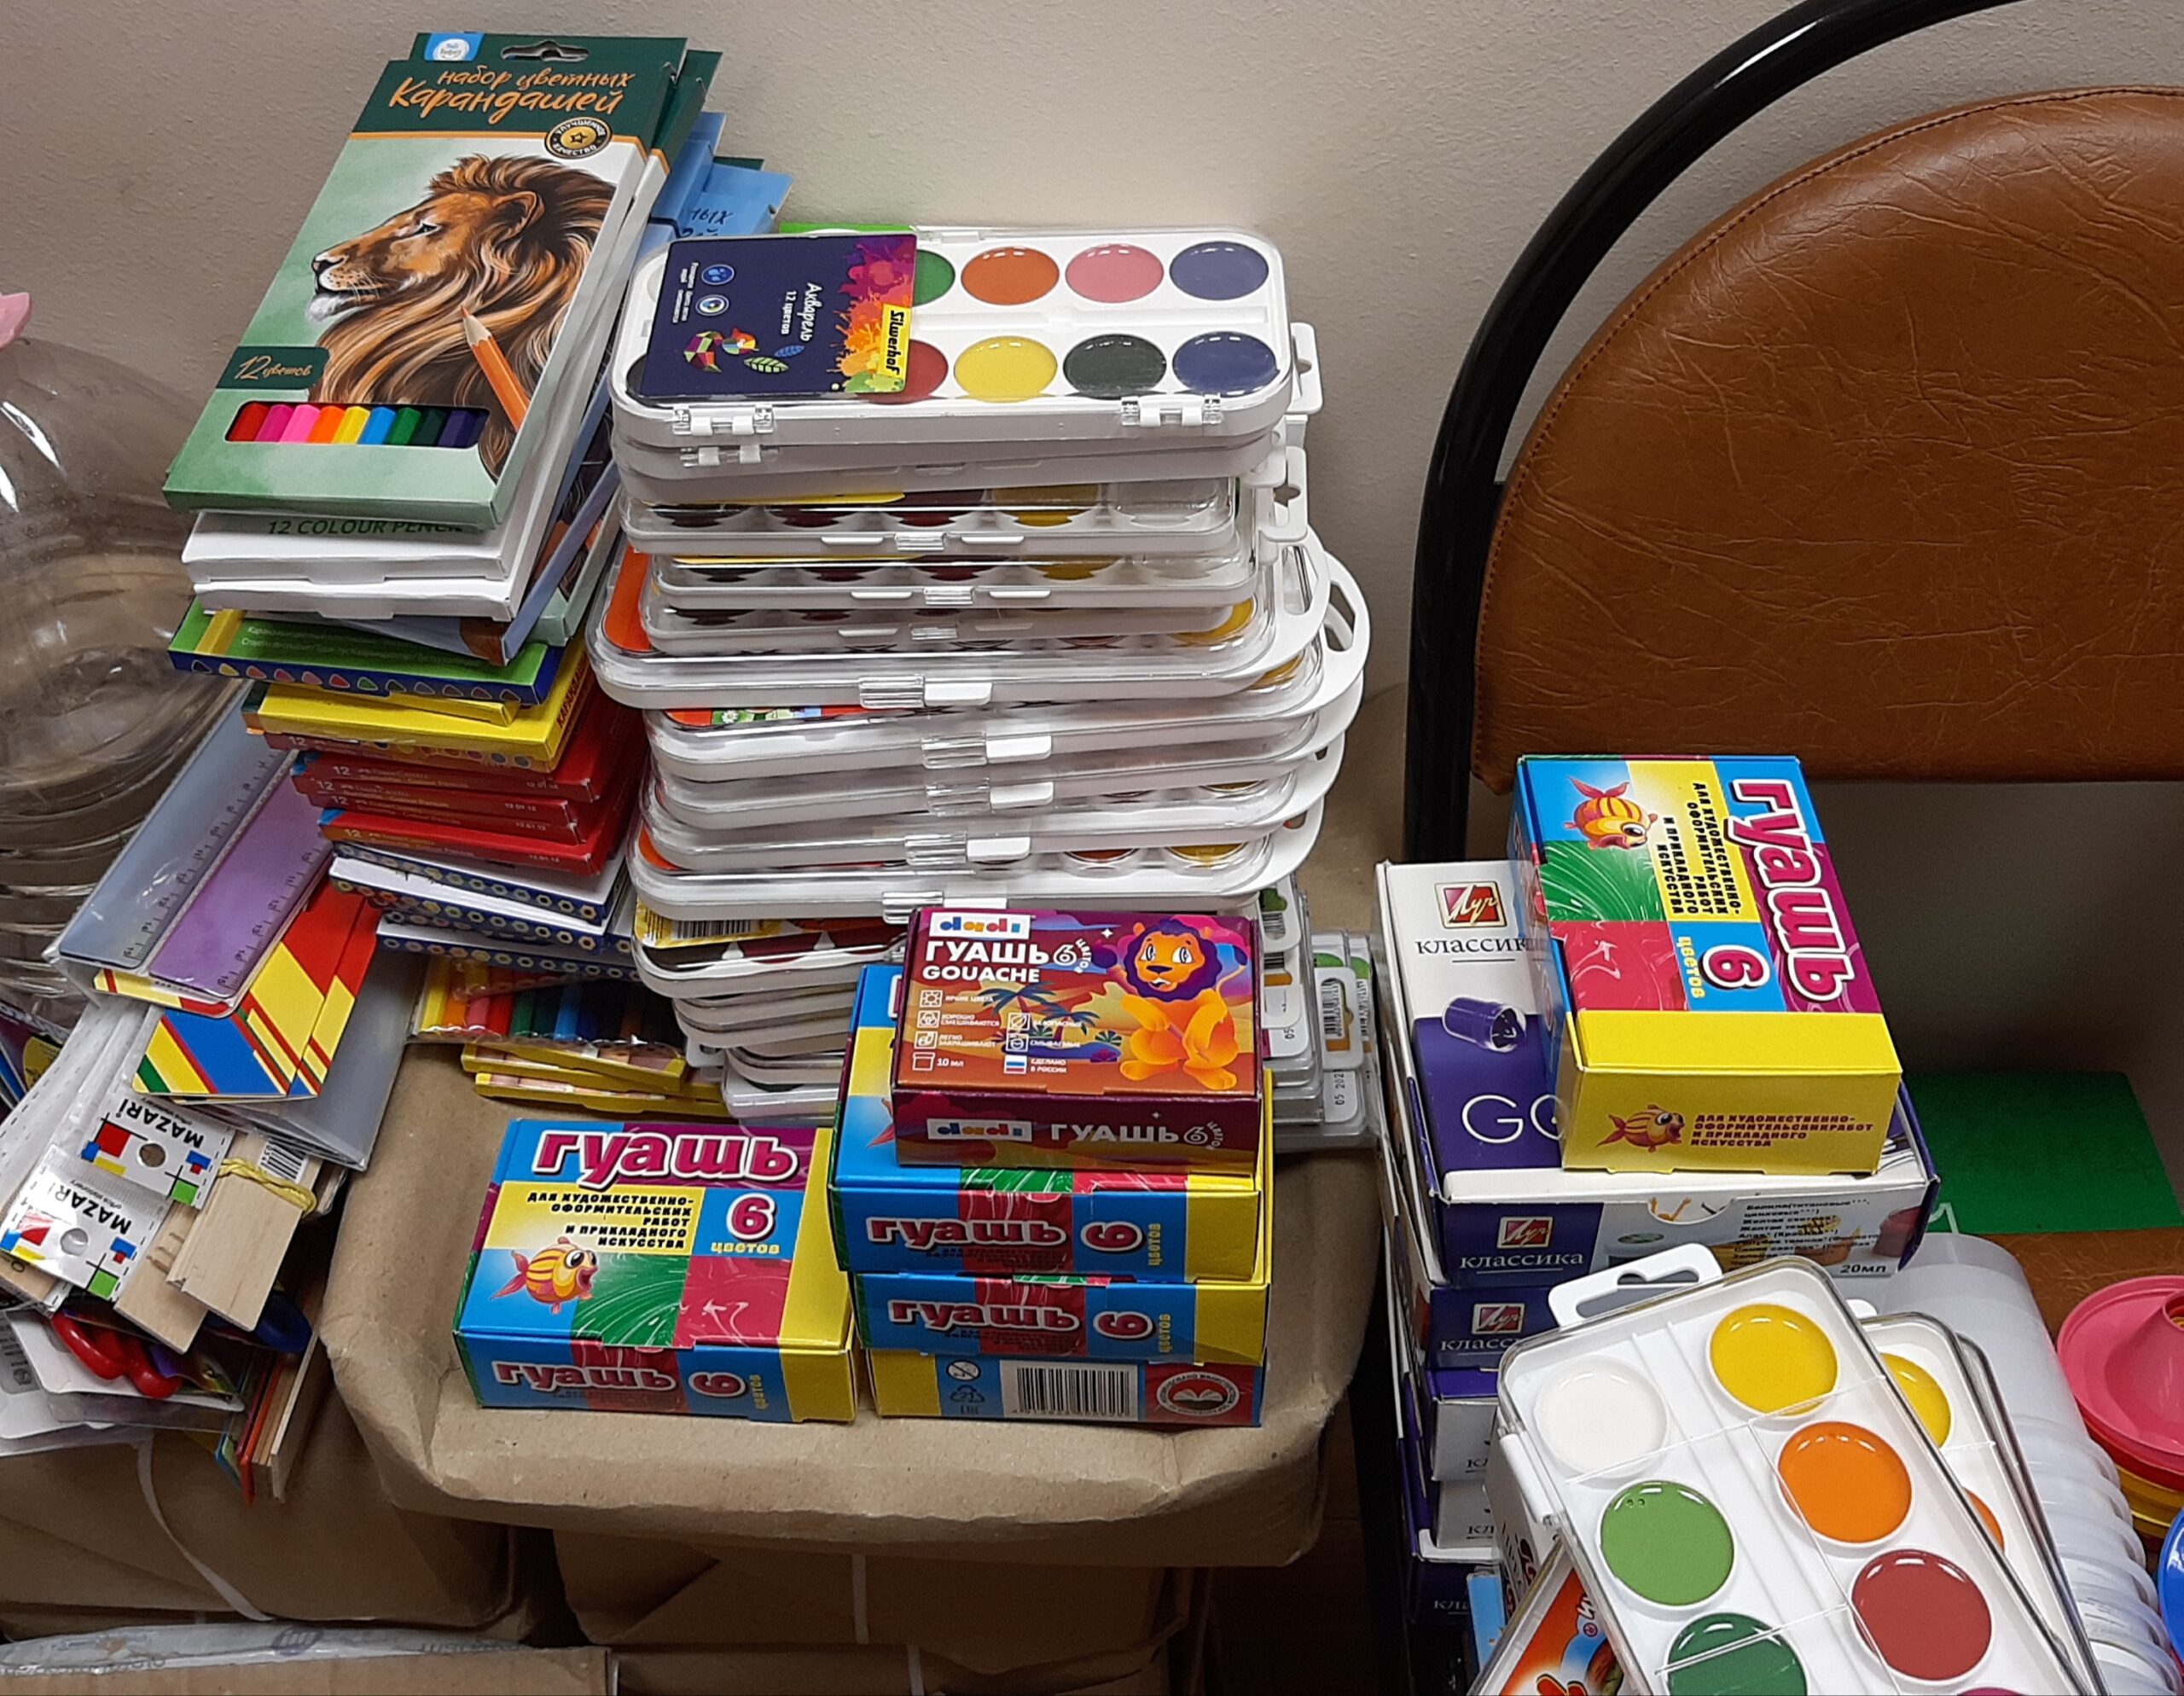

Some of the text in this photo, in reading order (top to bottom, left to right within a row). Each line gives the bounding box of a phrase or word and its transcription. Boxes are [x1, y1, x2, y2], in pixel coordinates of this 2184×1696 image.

[437, 66, 636, 91] набор цветных
[389, 77, 624, 125] Карандашей
[781, 290, 797, 335] 12 цветов
[800, 282, 822, 341] Акварель
[885, 311, 905, 375] Silwerhof
[235, 355, 272, 380] 12
[269, 520, 292, 534] 12
[298, 519, 385, 534] COLOUR
[288, 736, 308, 746] 12
[333, 766, 351, 776] 12
[317, 781, 335, 792] 12
[1693, 782, 1711, 804] ДЛЯ
[331, 795, 350, 806] 12
[343, 828, 363, 839] 12
[1656, 844, 1684, 914] ИСКУССТВА
[1665, 828, 1699, 914] ПРИКЛАДНОГО
[1693, 875, 1714, 915] РАБОТ
[926, 938, 1093, 973] ГУАШЬ 6 ЦВЕТОВ
[922, 965, 1040, 983] GOUACHE
[1676, 937, 1705, 998] цветов
[1701, 944, 1770, 989] 6
[937, 1058, 950, 1067] 10
[1333, 1072, 1345, 1090] 202
[1695, 1114, 1725, 1123] ДЛЯ
[1051, 1124, 1179, 1143] ГУАШЬ
[1183, 1126, 1209, 1145] 6
[531, 1131, 799, 1190] гуашь
[527, 1192, 694, 1206] ДЛЯ ХУДОЖЕСТВЕННО-
[551, 1204, 692, 1217] ОФОРМИТЕЛЬСКИХ
[726, 1193, 779, 1240] 6
[565, 1225, 687, 1238] И ПРИКЛАДНОГО
[642, 1217, 690, 1227] РАБОТ
[597, 1237, 685, 1249] ИСКУССТВА
[866, 1217, 1143, 1252] гуашь 6
[711, 1242, 780, 1254] цветов
[1460, 1253, 1584, 1269] классика
[1840, 1263, 1887, 1274] 20мл
[887, 1299, 1153, 1339] гуашь 6
[1441, 1338, 1520, 1351] класс
[491, 1361, 746, 1397] гуашь 6
